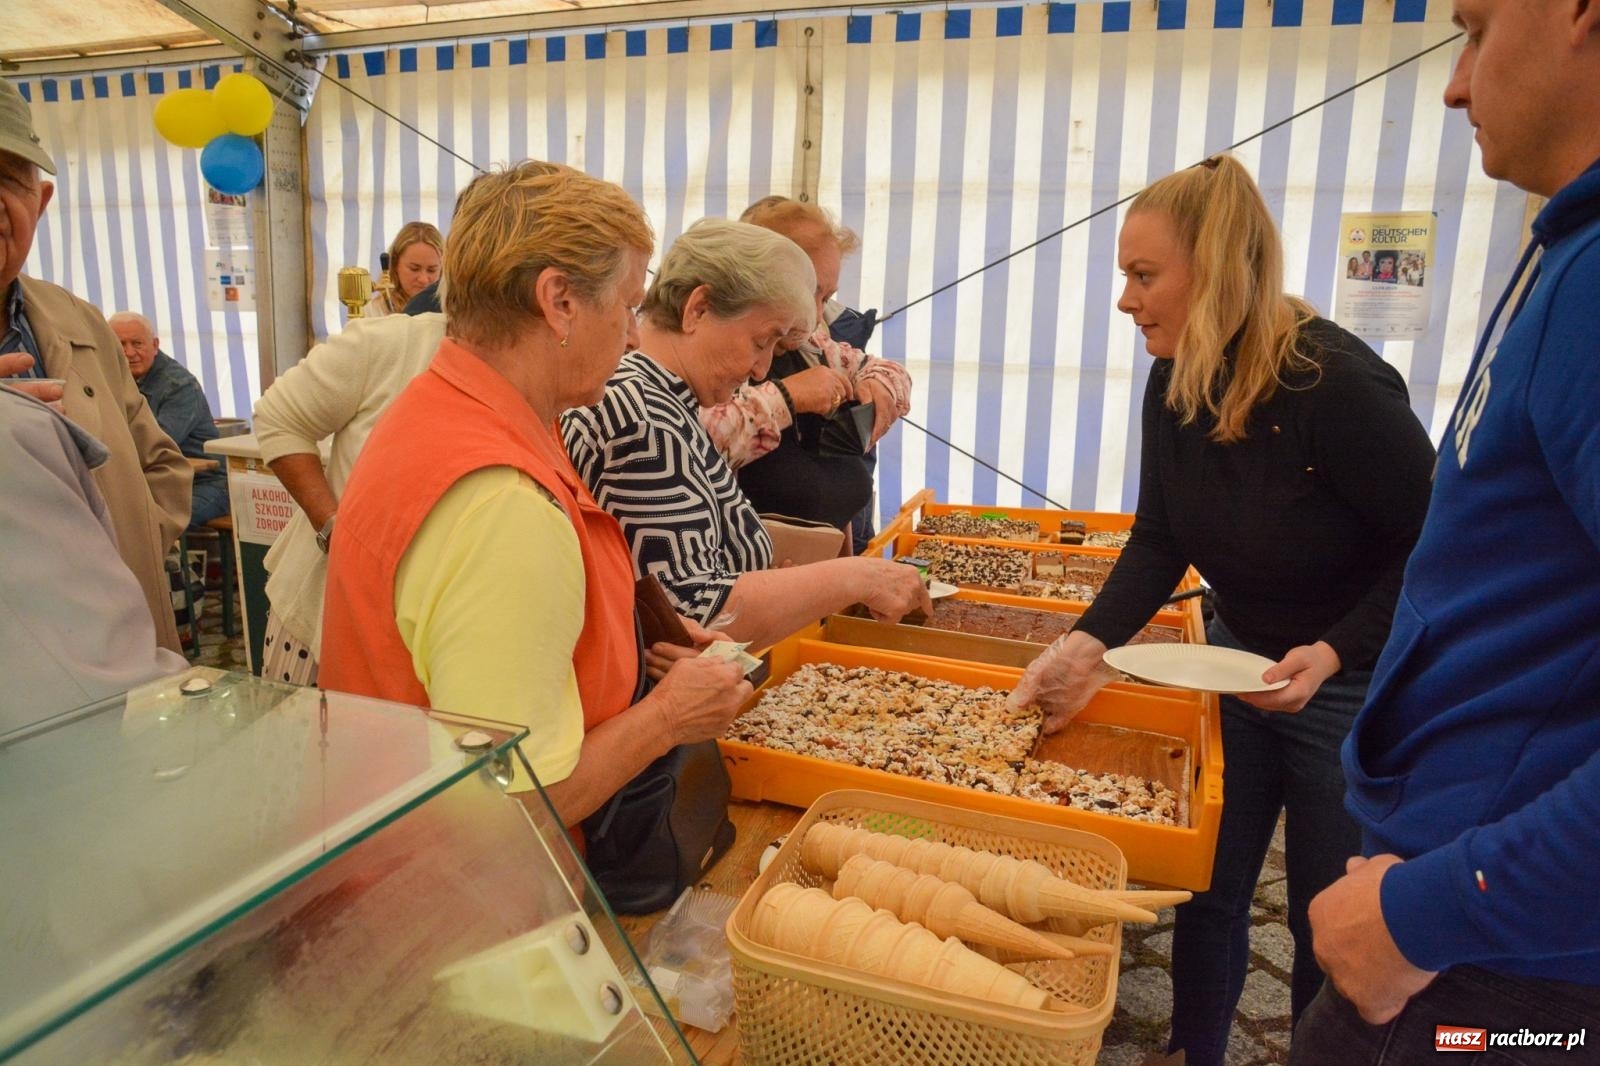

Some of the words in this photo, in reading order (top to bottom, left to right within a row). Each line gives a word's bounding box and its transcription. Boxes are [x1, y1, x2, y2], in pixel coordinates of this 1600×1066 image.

[1371, 235, 1407, 243] KULTUR
[1372, 228, 1427, 237] DEUTSCHEN
[252, 488, 292, 504] ALKOHOL
[255, 503, 293, 518] SZKODZI
[256, 517, 289, 532] ZDROW
